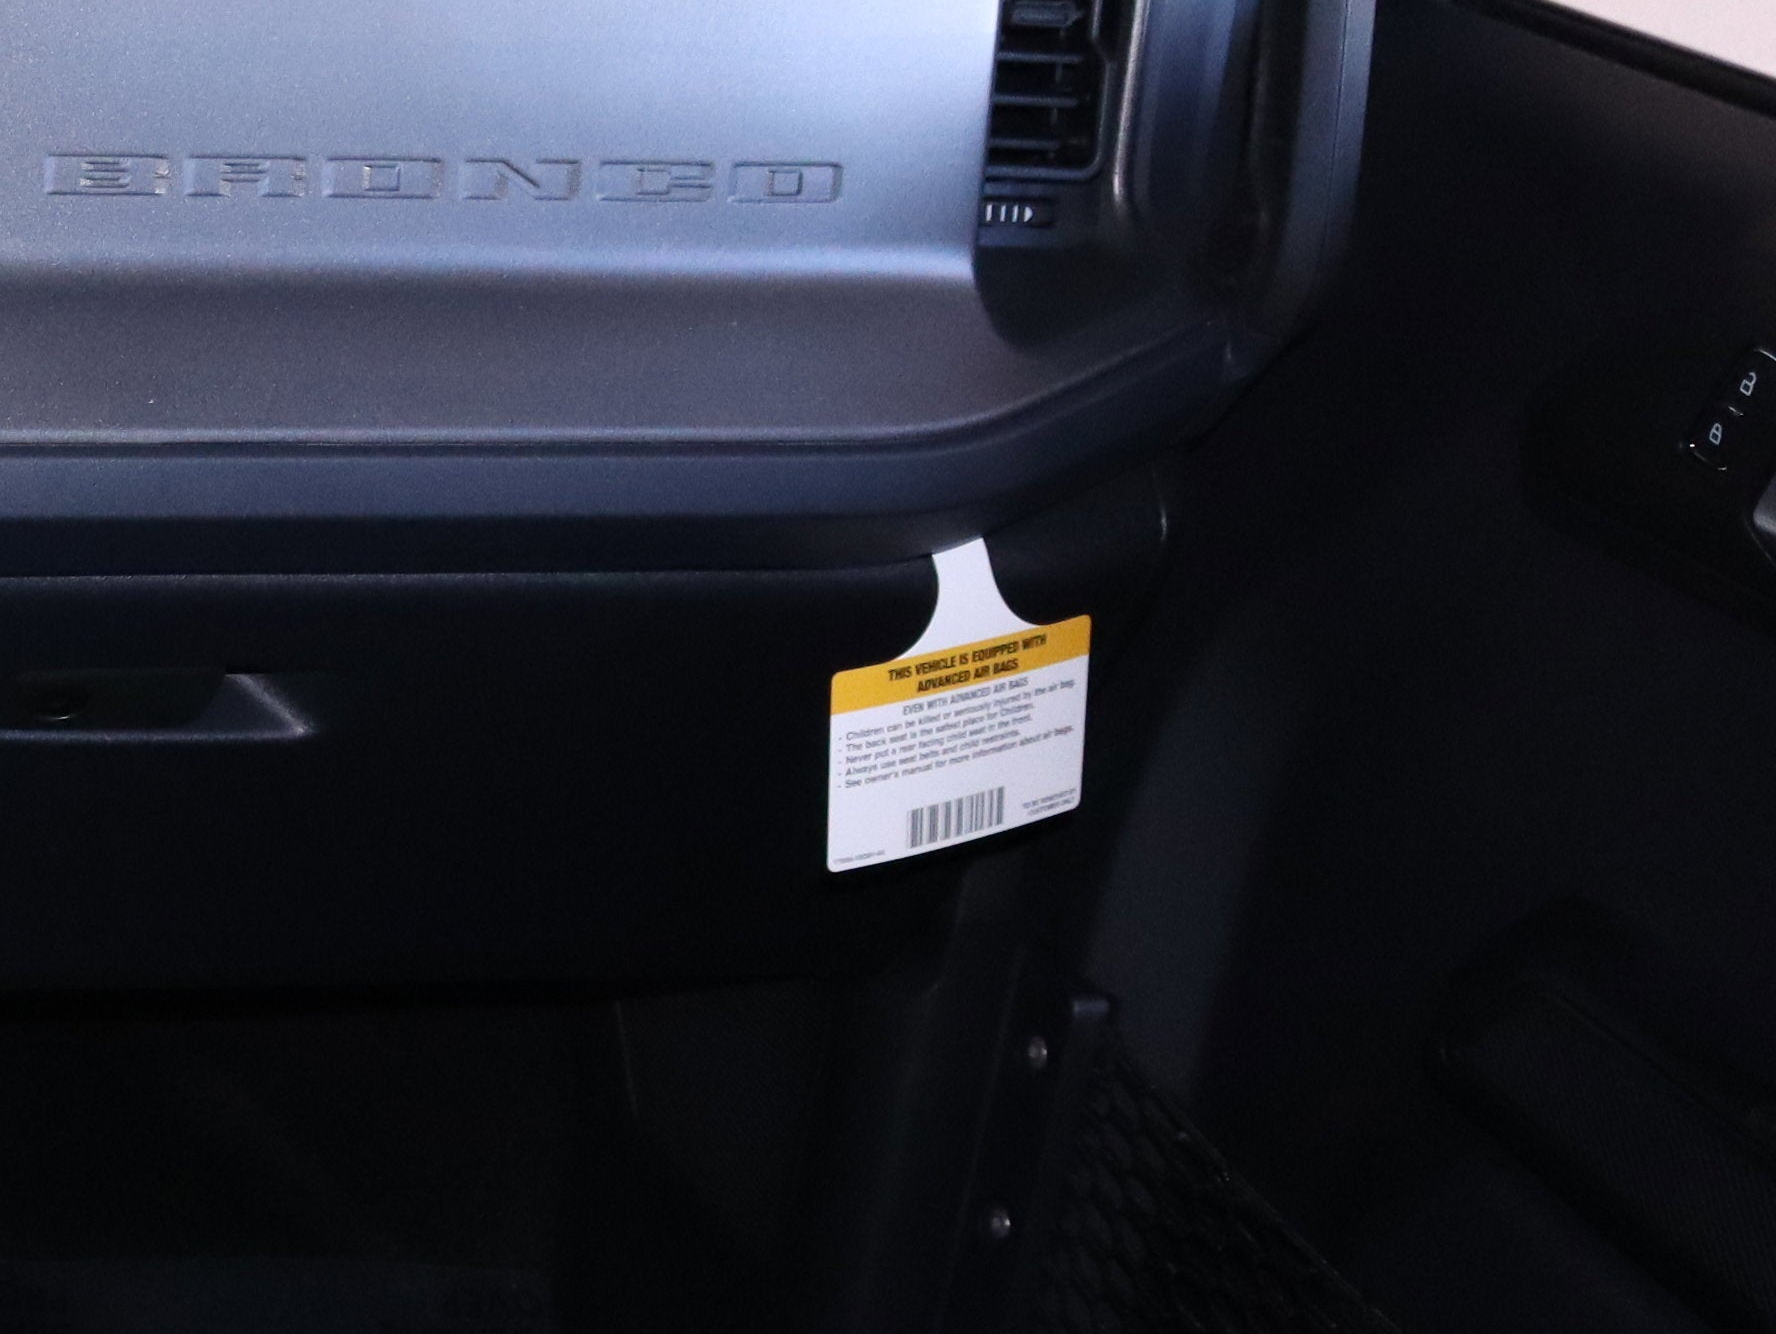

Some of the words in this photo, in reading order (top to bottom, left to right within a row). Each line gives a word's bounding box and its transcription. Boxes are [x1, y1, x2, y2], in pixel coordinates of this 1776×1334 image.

[46, 152, 844, 204] BRONCO
[888, 666, 912, 681] THIS
[915, 656, 957, 675] VEHICLE
[959, 652, 969, 665] IS
[972, 641, 1020, 663] EQUIPPED
[1021, 634, 1047, 649] WITH
[917, 669, 970, 692] ADVANCED
[974, 665, 989, 678] AIR
[993, 658, 1018, 674] BAGS
